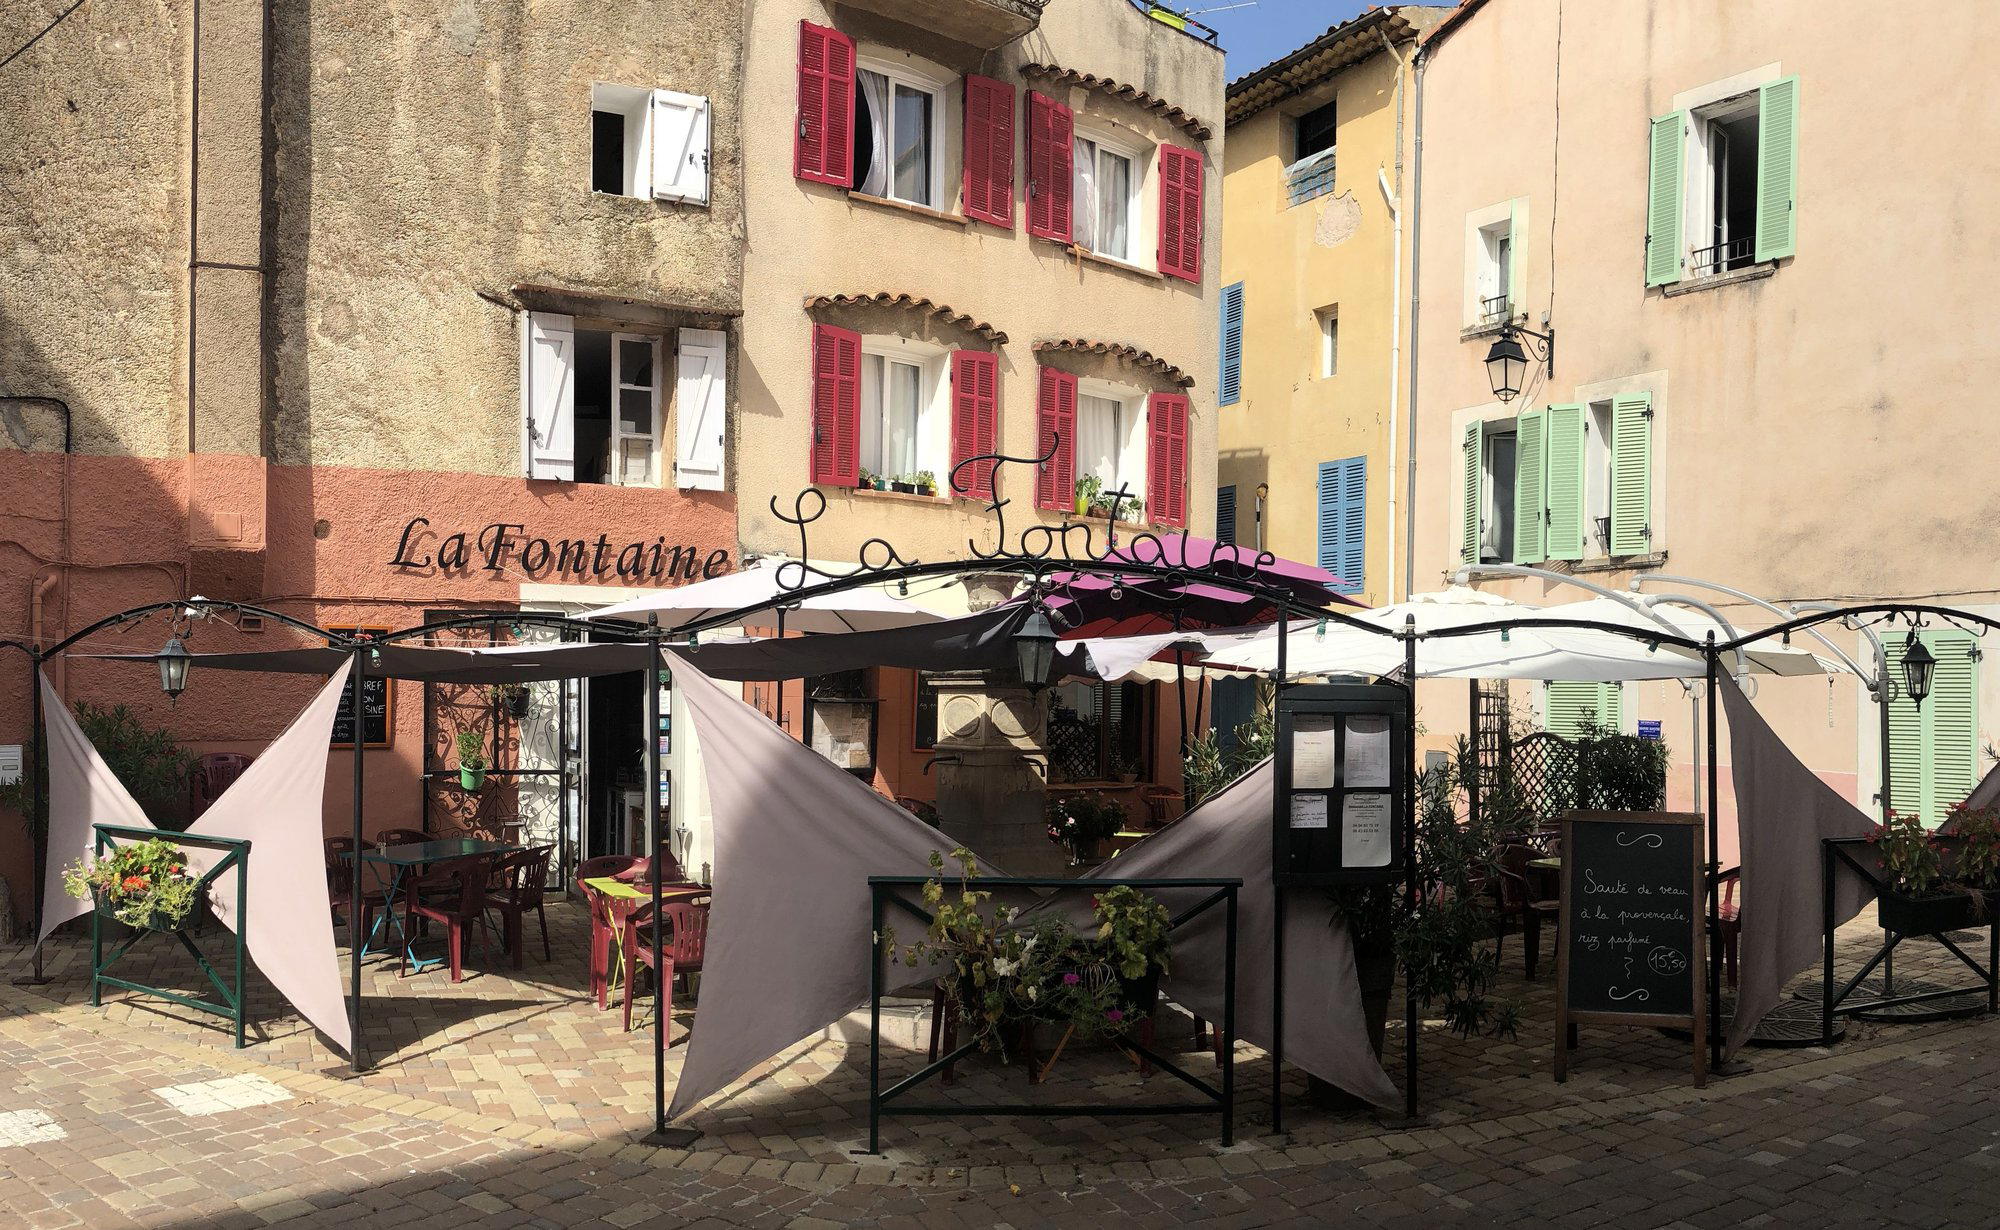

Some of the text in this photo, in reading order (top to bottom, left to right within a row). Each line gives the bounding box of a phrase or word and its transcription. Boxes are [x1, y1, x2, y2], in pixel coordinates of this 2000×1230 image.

[770, 431, 1275, 590] La Fontaine
[387, 517, 729, 580] La Fontaine
[1583, 868, 1689, 896] Sauté de veau
[1580, 909, 1591, 919] à
[1595, 905, 1609, 920] la
[1578, 931, 1651, 952] riz parfumé
